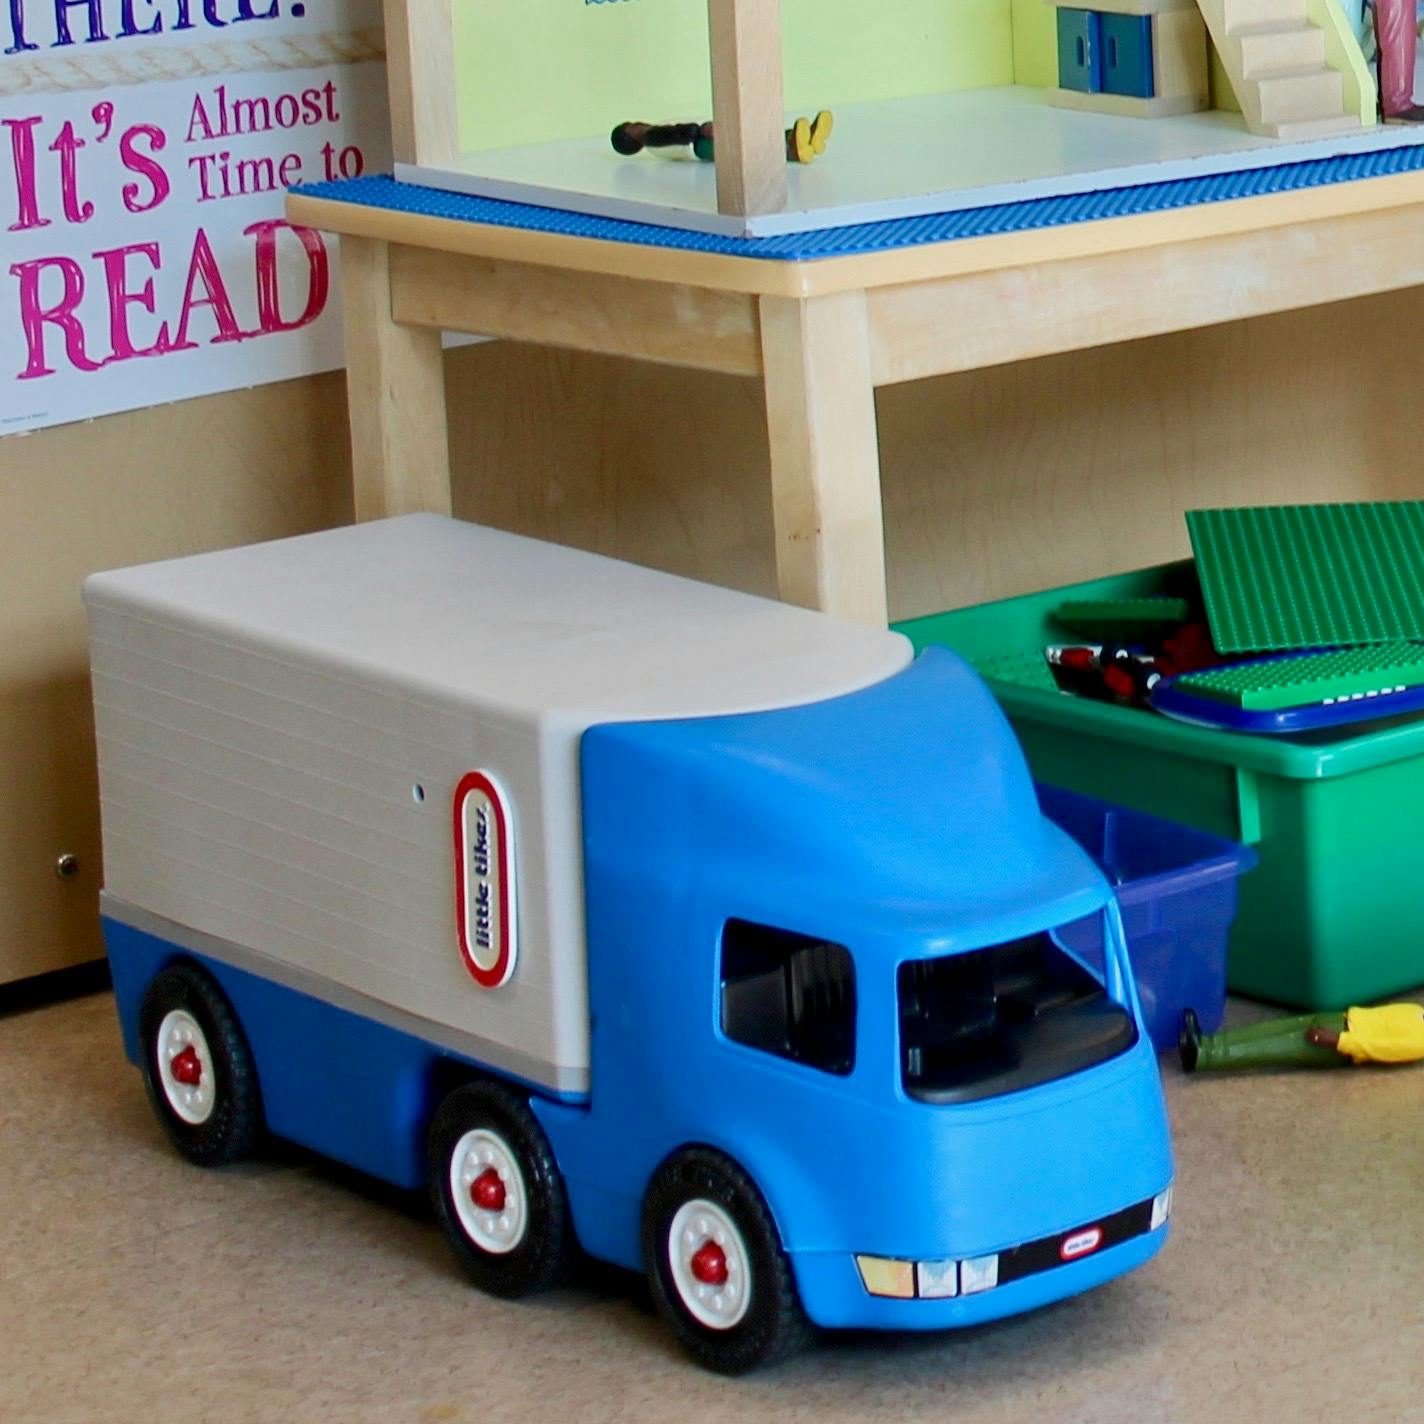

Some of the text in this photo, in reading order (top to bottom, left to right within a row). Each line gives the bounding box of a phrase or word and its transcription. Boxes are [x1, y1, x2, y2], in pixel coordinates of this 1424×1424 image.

[184, 79, 341, 145] Almost
[0, 100, 172, 232] It's
[188, 139, 365, 204] Time to
[8, 218, 330, 381] READ
[475, 880, 491, 950] little
